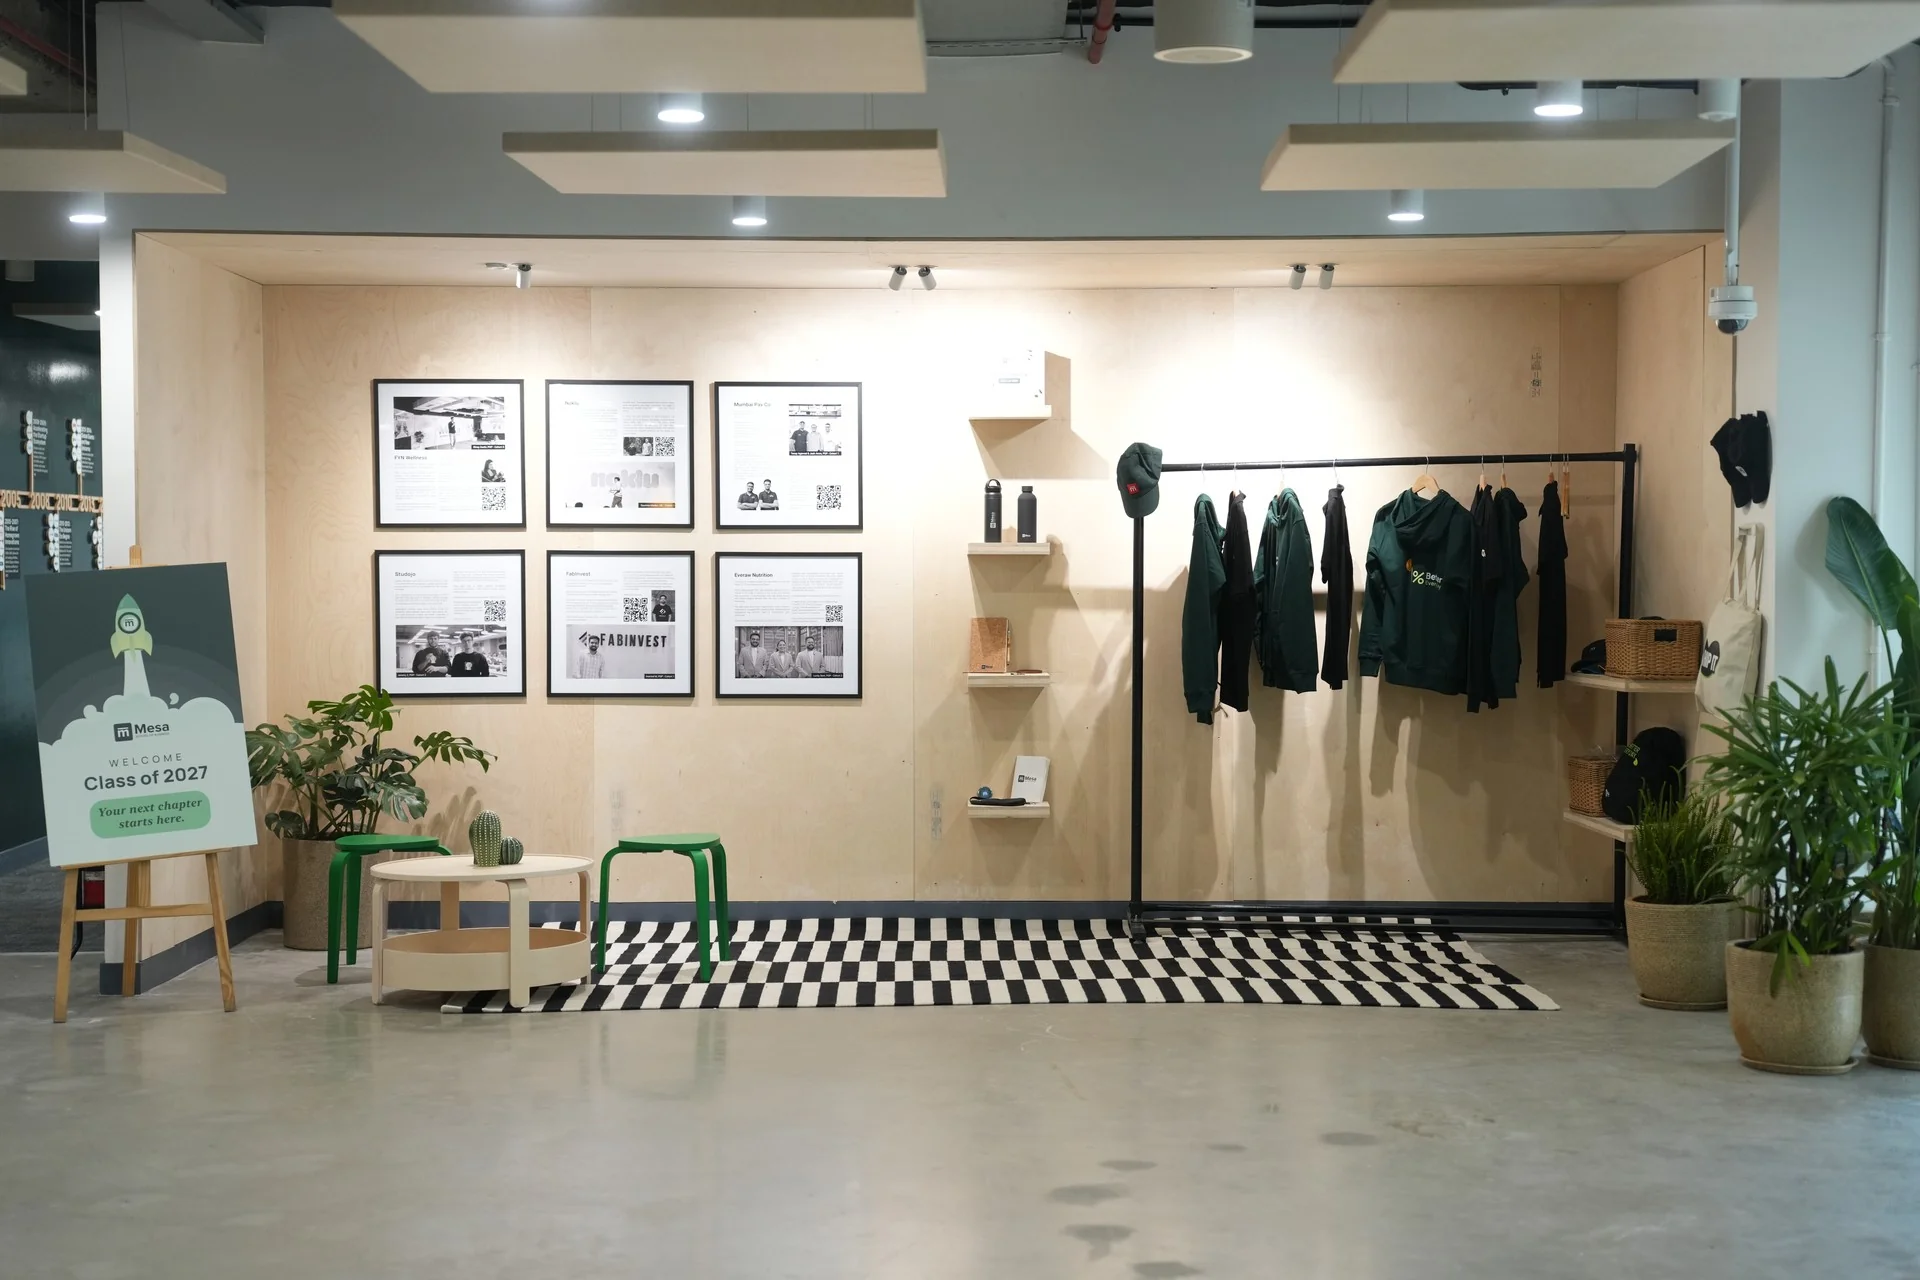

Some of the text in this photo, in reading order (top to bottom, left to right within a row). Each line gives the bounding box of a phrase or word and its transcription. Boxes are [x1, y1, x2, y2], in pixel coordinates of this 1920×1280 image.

[1, 490, 21, 508] 2005
[31, 492, 50, 510] 2008
[56, 493, 72, 511] 2010
[600, 633, 667, 649] FABINVEST
[134, 723, 170, 735] Mesa
[108, 753, 183, 768] WELCOME
[84, 765, 208, 791] Class of 2027
[98, 799, 203, 818] Your next chapter
[118, 814, 185, 829] starts here.
